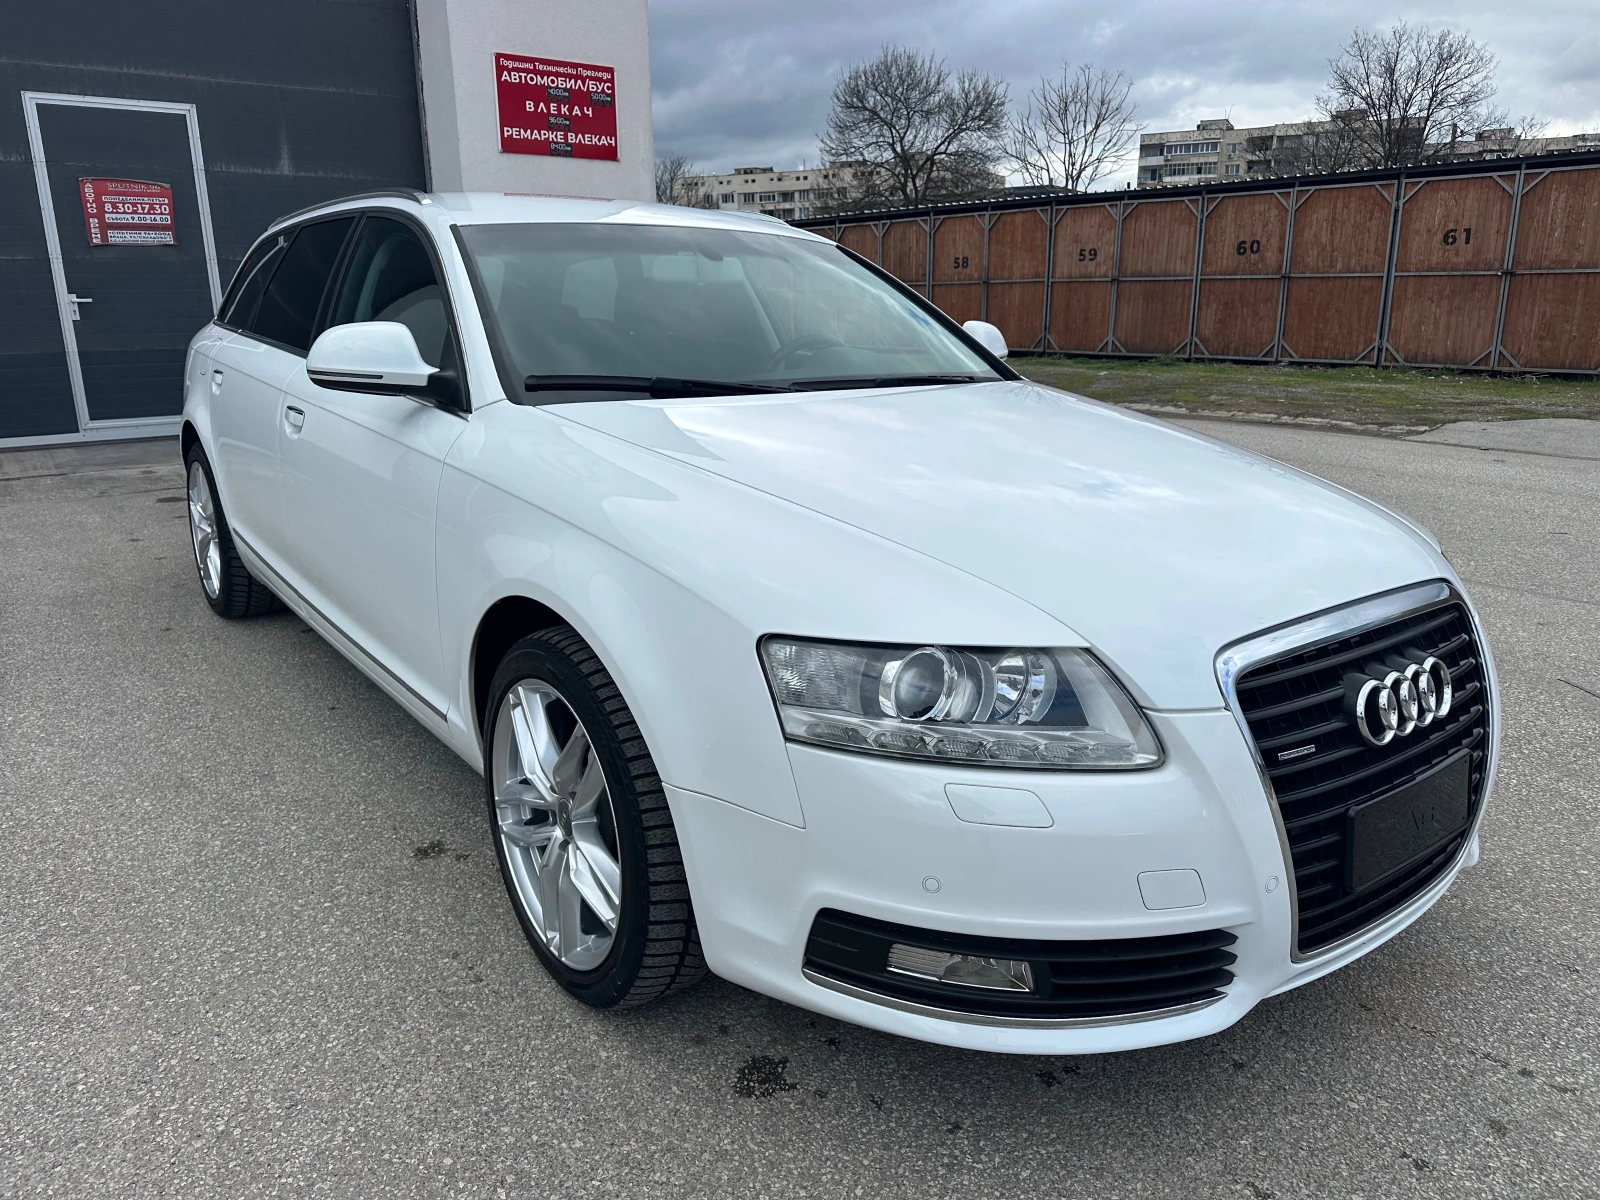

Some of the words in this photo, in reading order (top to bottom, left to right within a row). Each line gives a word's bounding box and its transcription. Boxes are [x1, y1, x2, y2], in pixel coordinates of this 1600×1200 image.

[500, 58, 534, 69] Годишни
[535, 62, 577, 74] Технически
[578, 67, 612, 79] Прегледи
[501, 71, 613, 93] АВТОМОБИЛ/БУС
[525, 100, 593, 118] ВЛЕКАЧ
[503, 126, 565, 143] РЕМАРКЕ
[567, 132, 616, 147] ВЛЕКАЧ
[107, 182, 148, 190] SPUTNIK
[83, 179, 98, 213] АБОТНО
[104, 203, 170, 214] 8.30-17.30
[130, 215, 169, 223] 9.00-16.00
[1443, 228, 1472, 246] 61
[1078, 247, 1098, 262] 59
[1235, 239, 1262, 256] 60
[953, 256, 969, 269] 58
